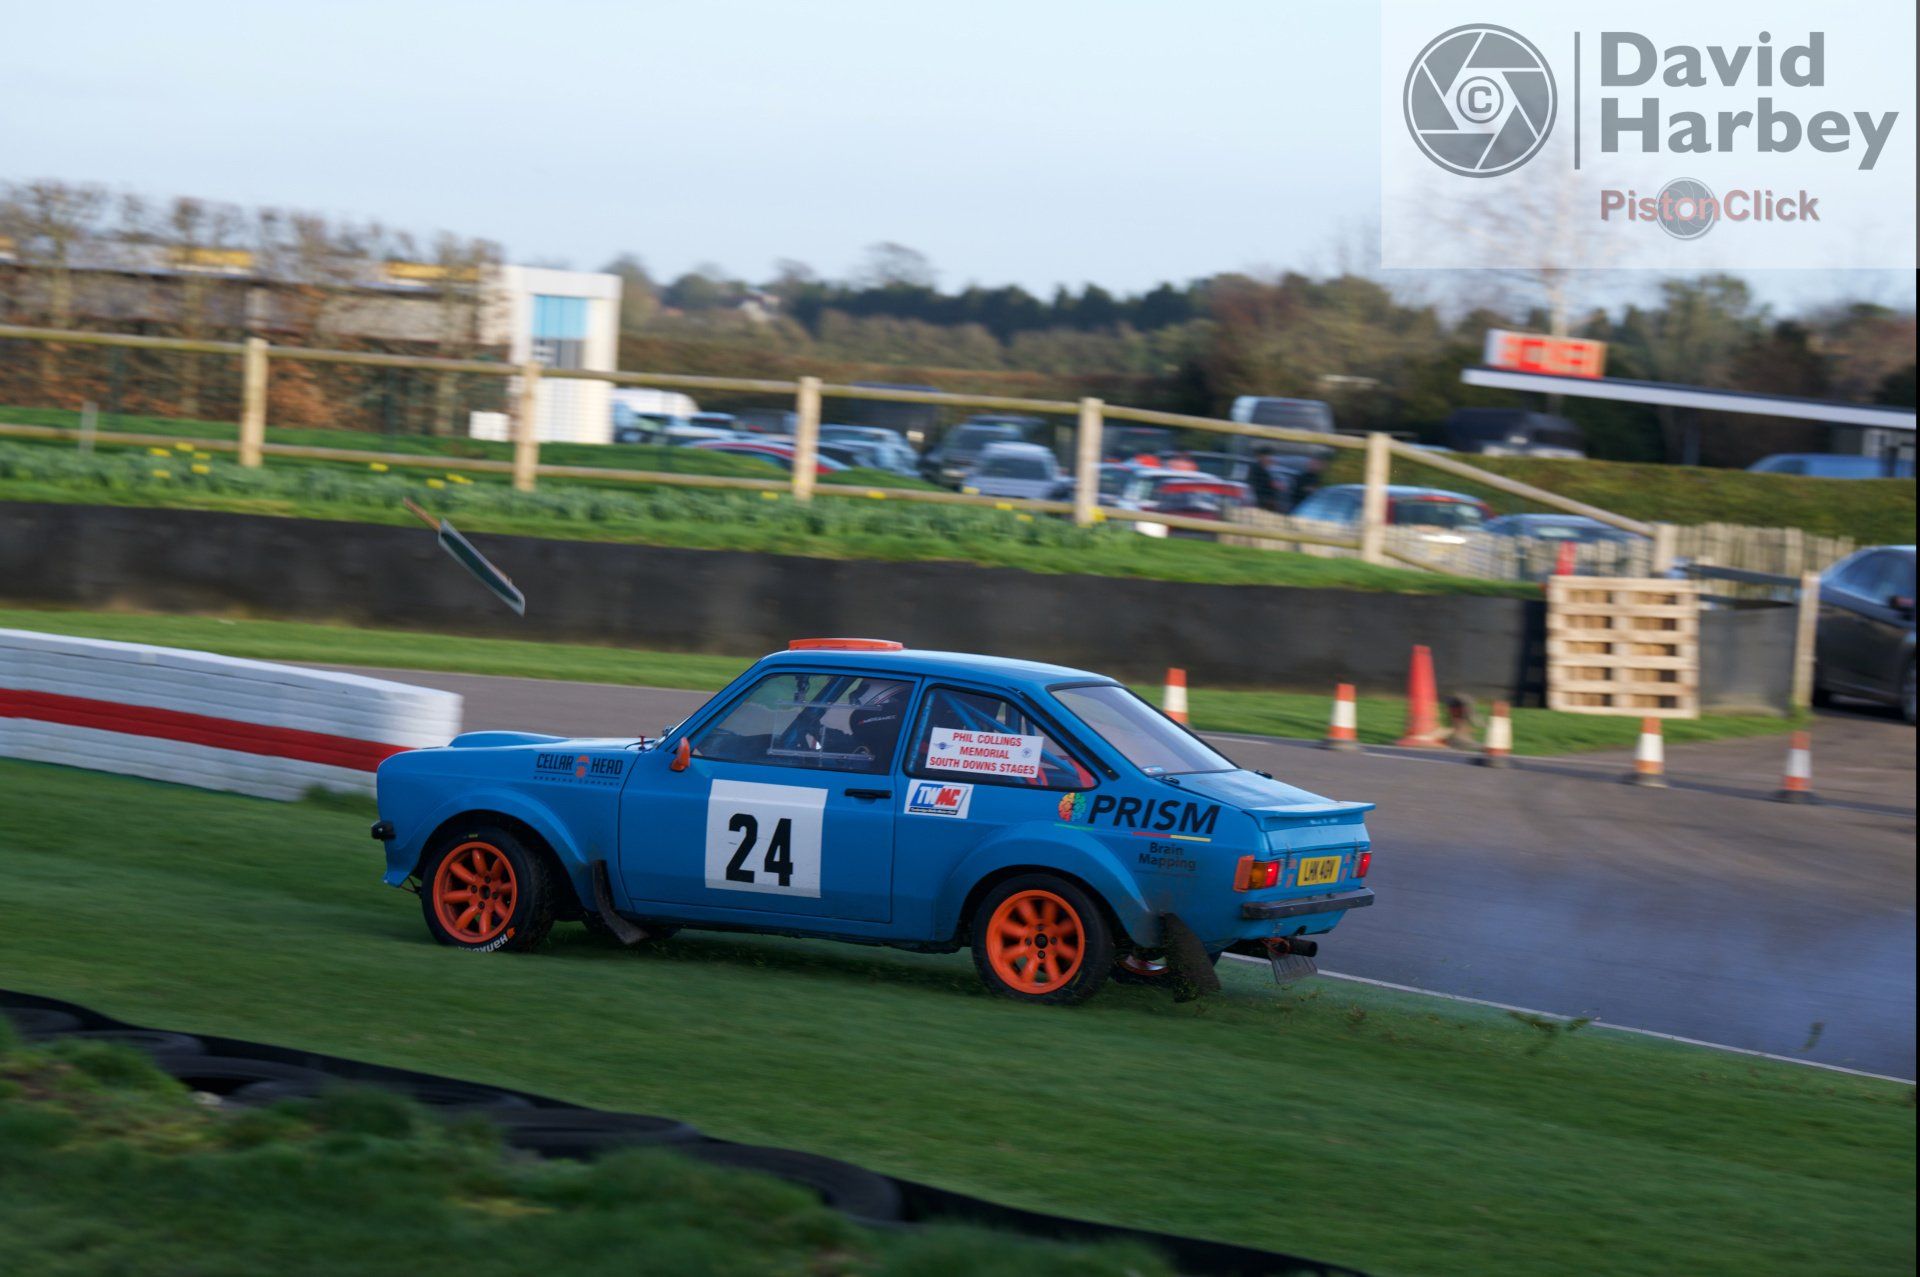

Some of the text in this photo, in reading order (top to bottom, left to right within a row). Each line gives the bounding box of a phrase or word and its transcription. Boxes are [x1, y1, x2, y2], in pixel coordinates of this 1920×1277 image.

[952, 732, 1022, 747] PHIL COLLINGS
[959, 746, 1010, 759] MEMORIAL
[536, 753, 624, 775] CELLAR HEAD
[929, 756, 1035, 775] SOUTH DOWNS STAGES
[1087, 794, 1222, 834] PRISM
[725, 813, 794, 887] 24
[1150, 841, 1184, 856] Brain
[1138, 852, 1197, 871] Mapping
